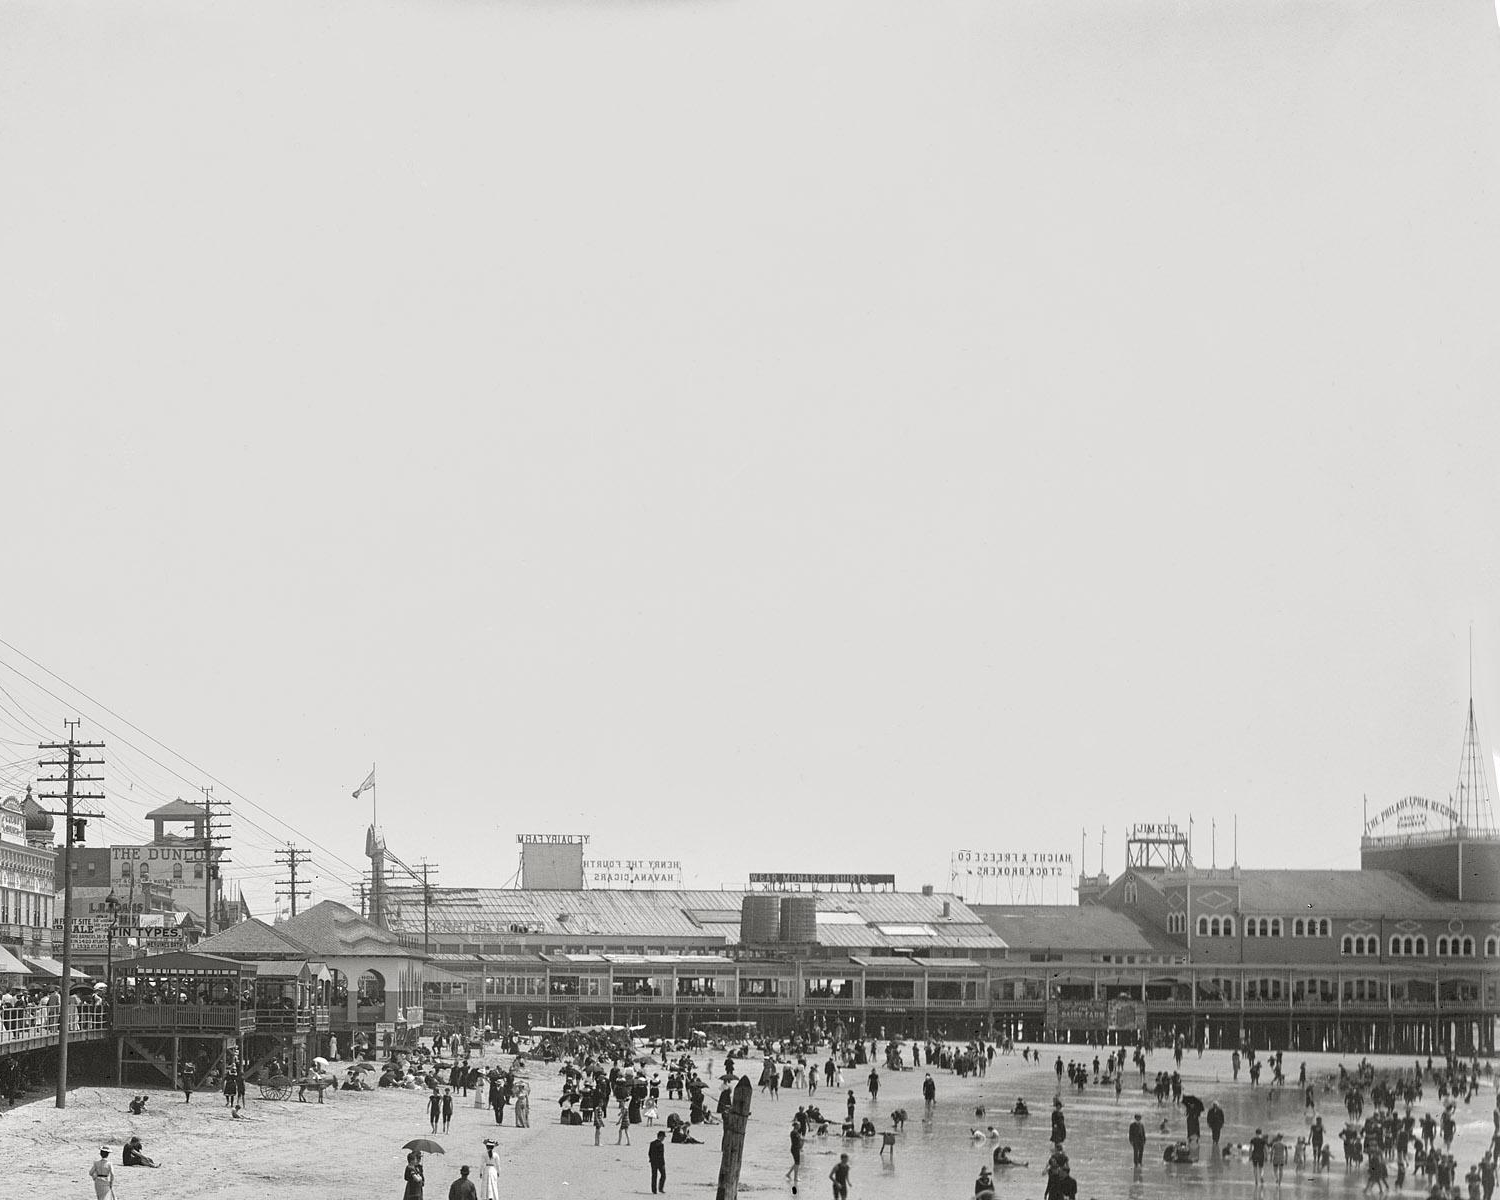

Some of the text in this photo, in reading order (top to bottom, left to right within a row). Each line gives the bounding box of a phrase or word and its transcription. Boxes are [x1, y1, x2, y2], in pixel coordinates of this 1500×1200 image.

[1381, 796, 1428, 822] PHILADELPHIA
[1137, 823, 1155, 833] JIM
[112, 847, 140, 860] THE
[751, 873, 869, 882] WEAR MONARCH SHIRTS
[73, 926, 94, 934] ALE
[112, 928, 131, 937] TIN
[135, 928, 182, 937] TYPES.
